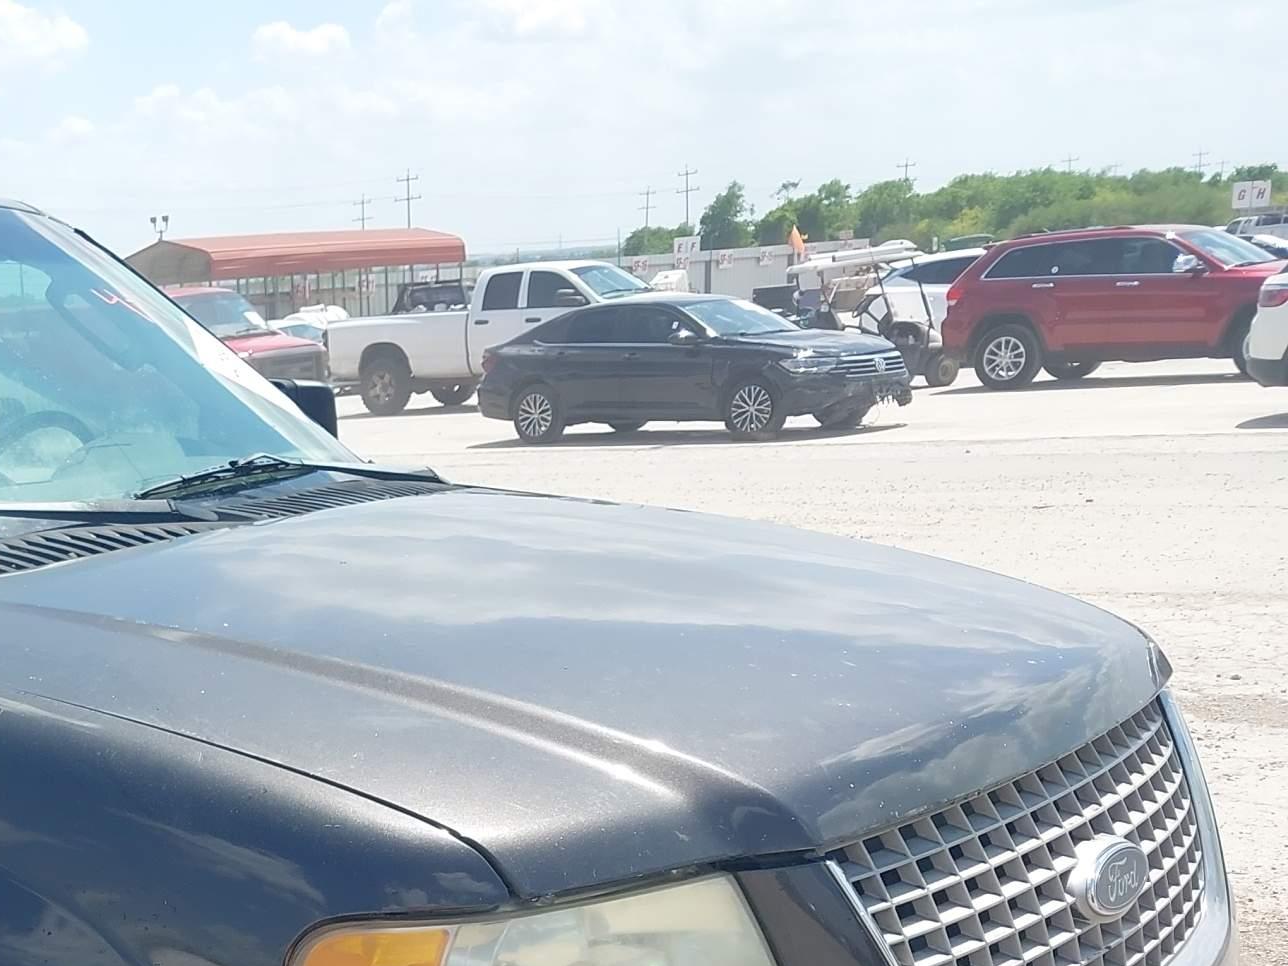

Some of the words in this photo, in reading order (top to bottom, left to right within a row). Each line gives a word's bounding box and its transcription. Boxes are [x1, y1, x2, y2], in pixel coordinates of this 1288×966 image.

[1238, 189, 1247, 200] G
[1256, 188, 1266, 199] H
[677, 243, 683, 253] E
[690, 241, 697, 252] F
[1108, 857, 1138, 902] Ford
